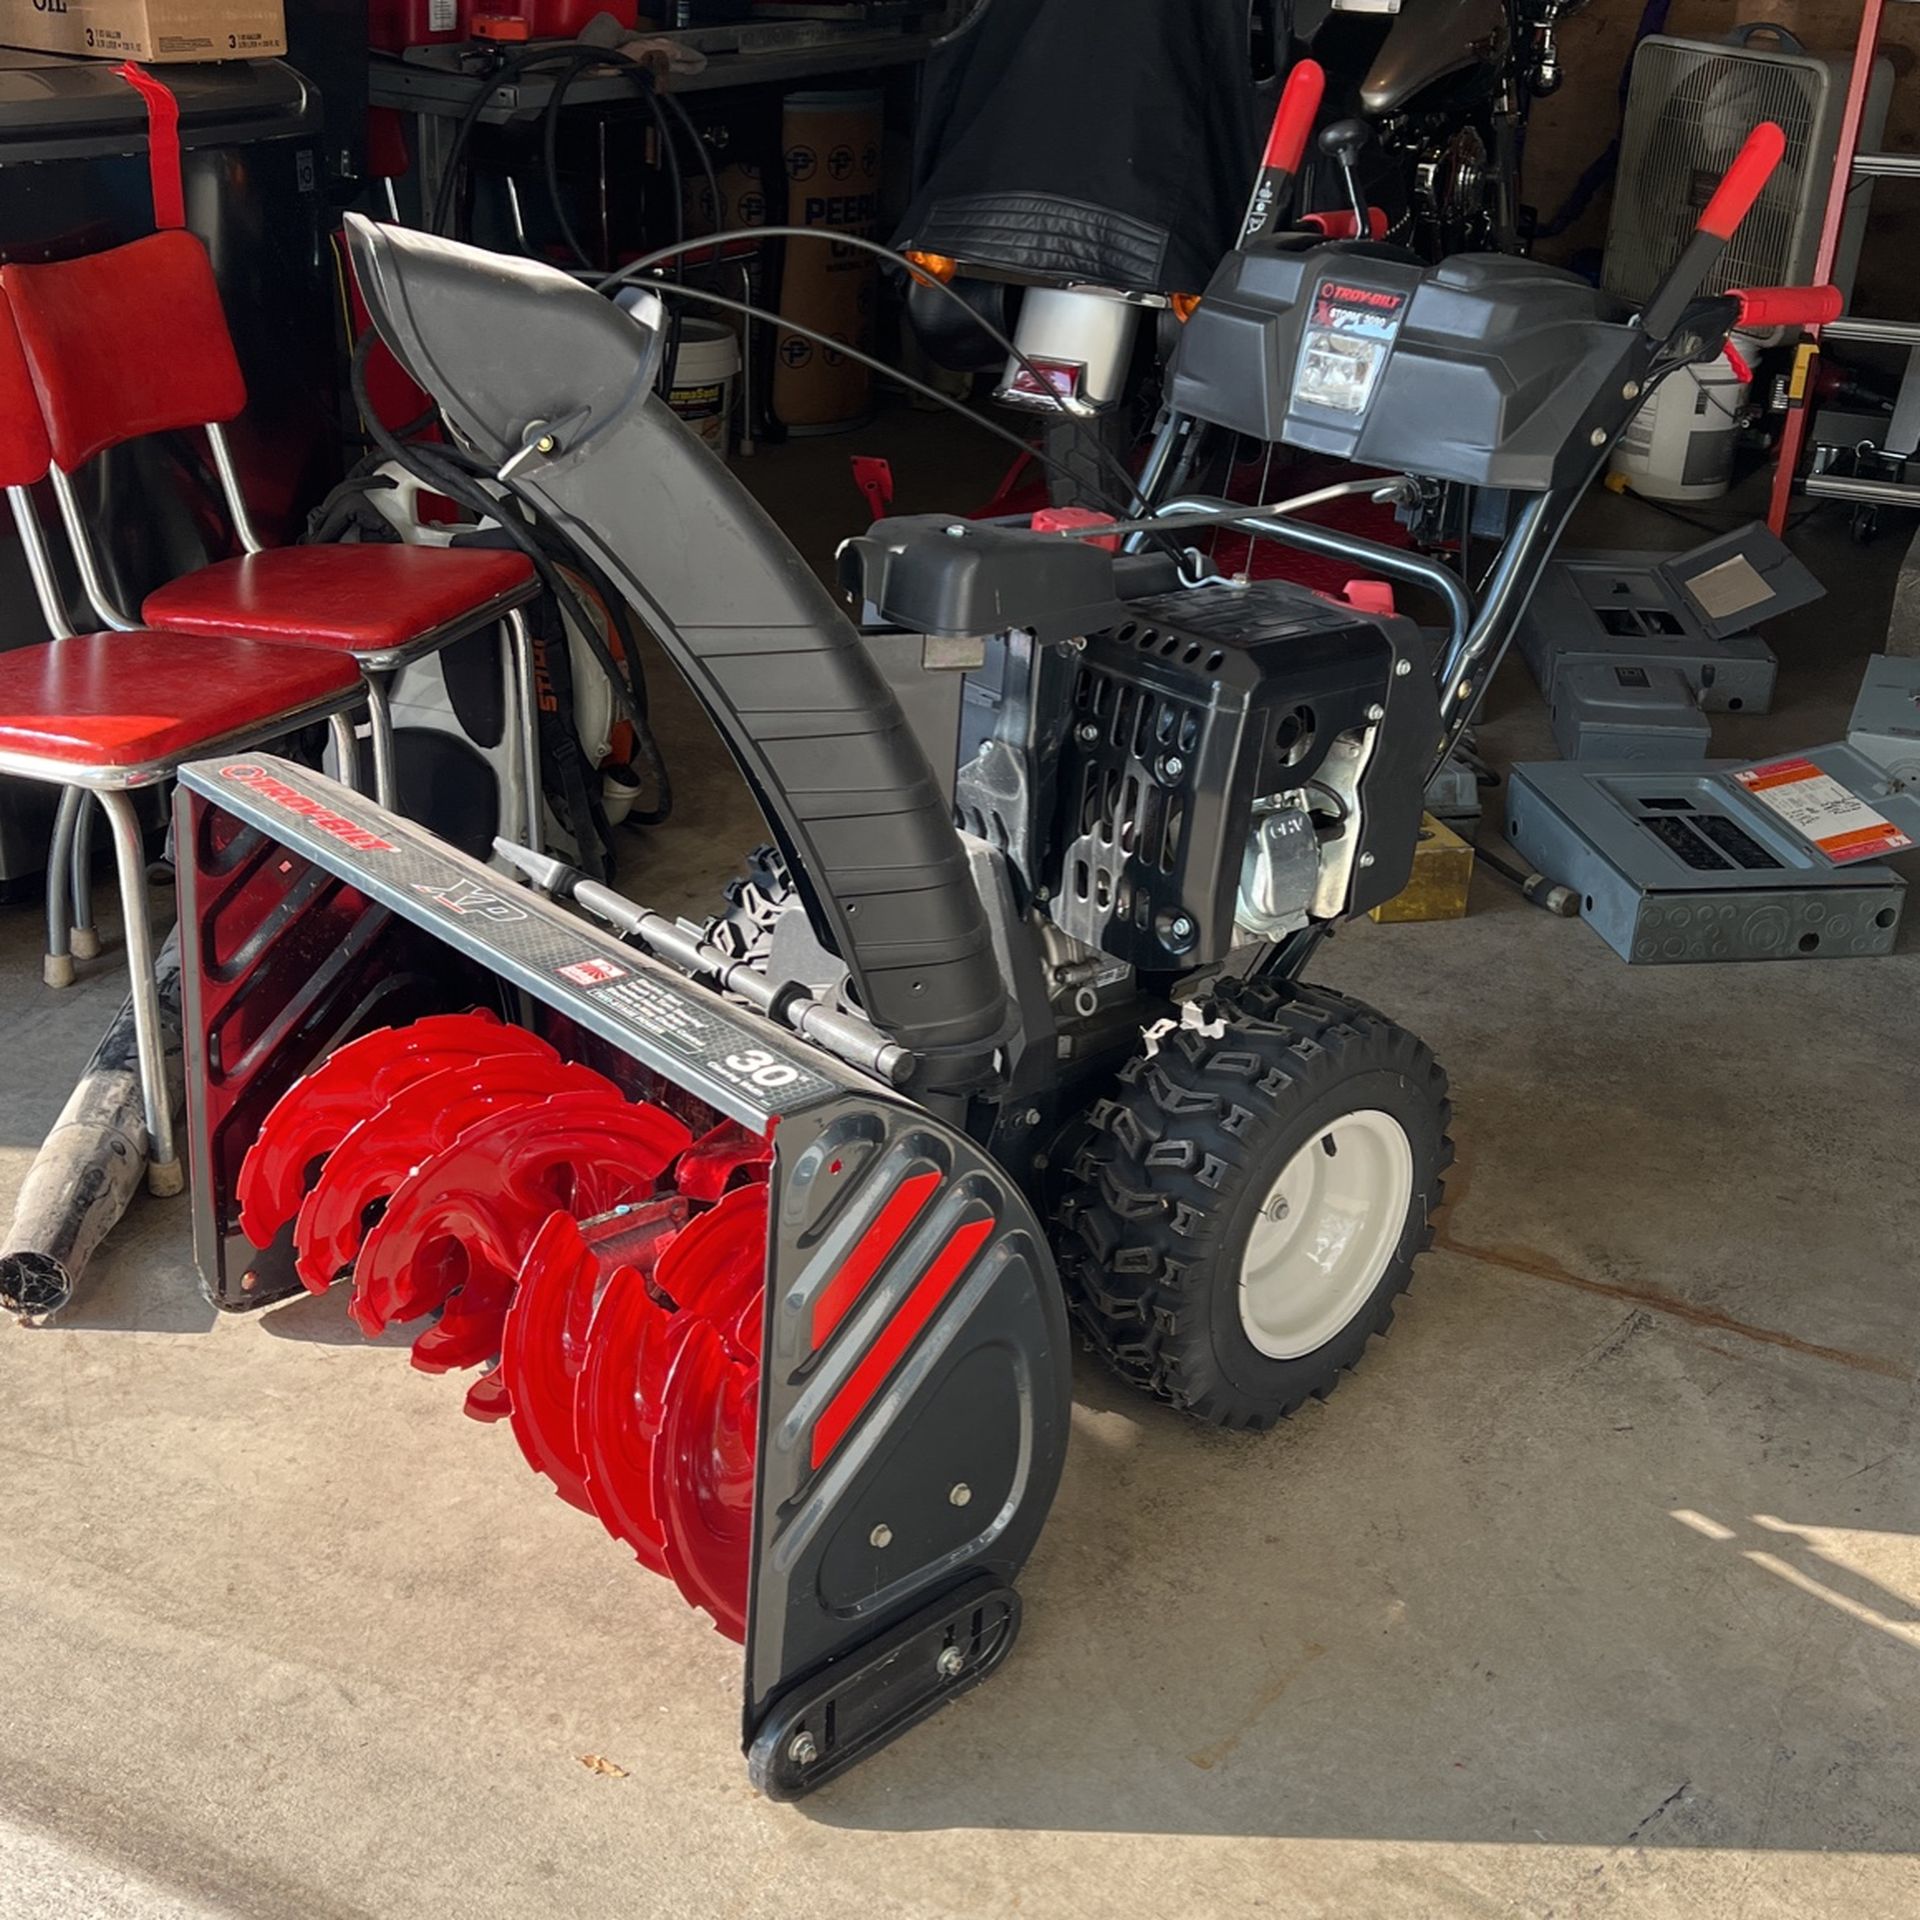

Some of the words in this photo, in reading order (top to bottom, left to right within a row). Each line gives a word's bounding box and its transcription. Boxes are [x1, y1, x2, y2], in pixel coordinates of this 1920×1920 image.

[85, 28, 95, 47] 3
[228, 34, 236, 48] 3
[1334, 285, 1401, 309] TROY-BILT
[240, 777, 400, 852] TROY-BILT
